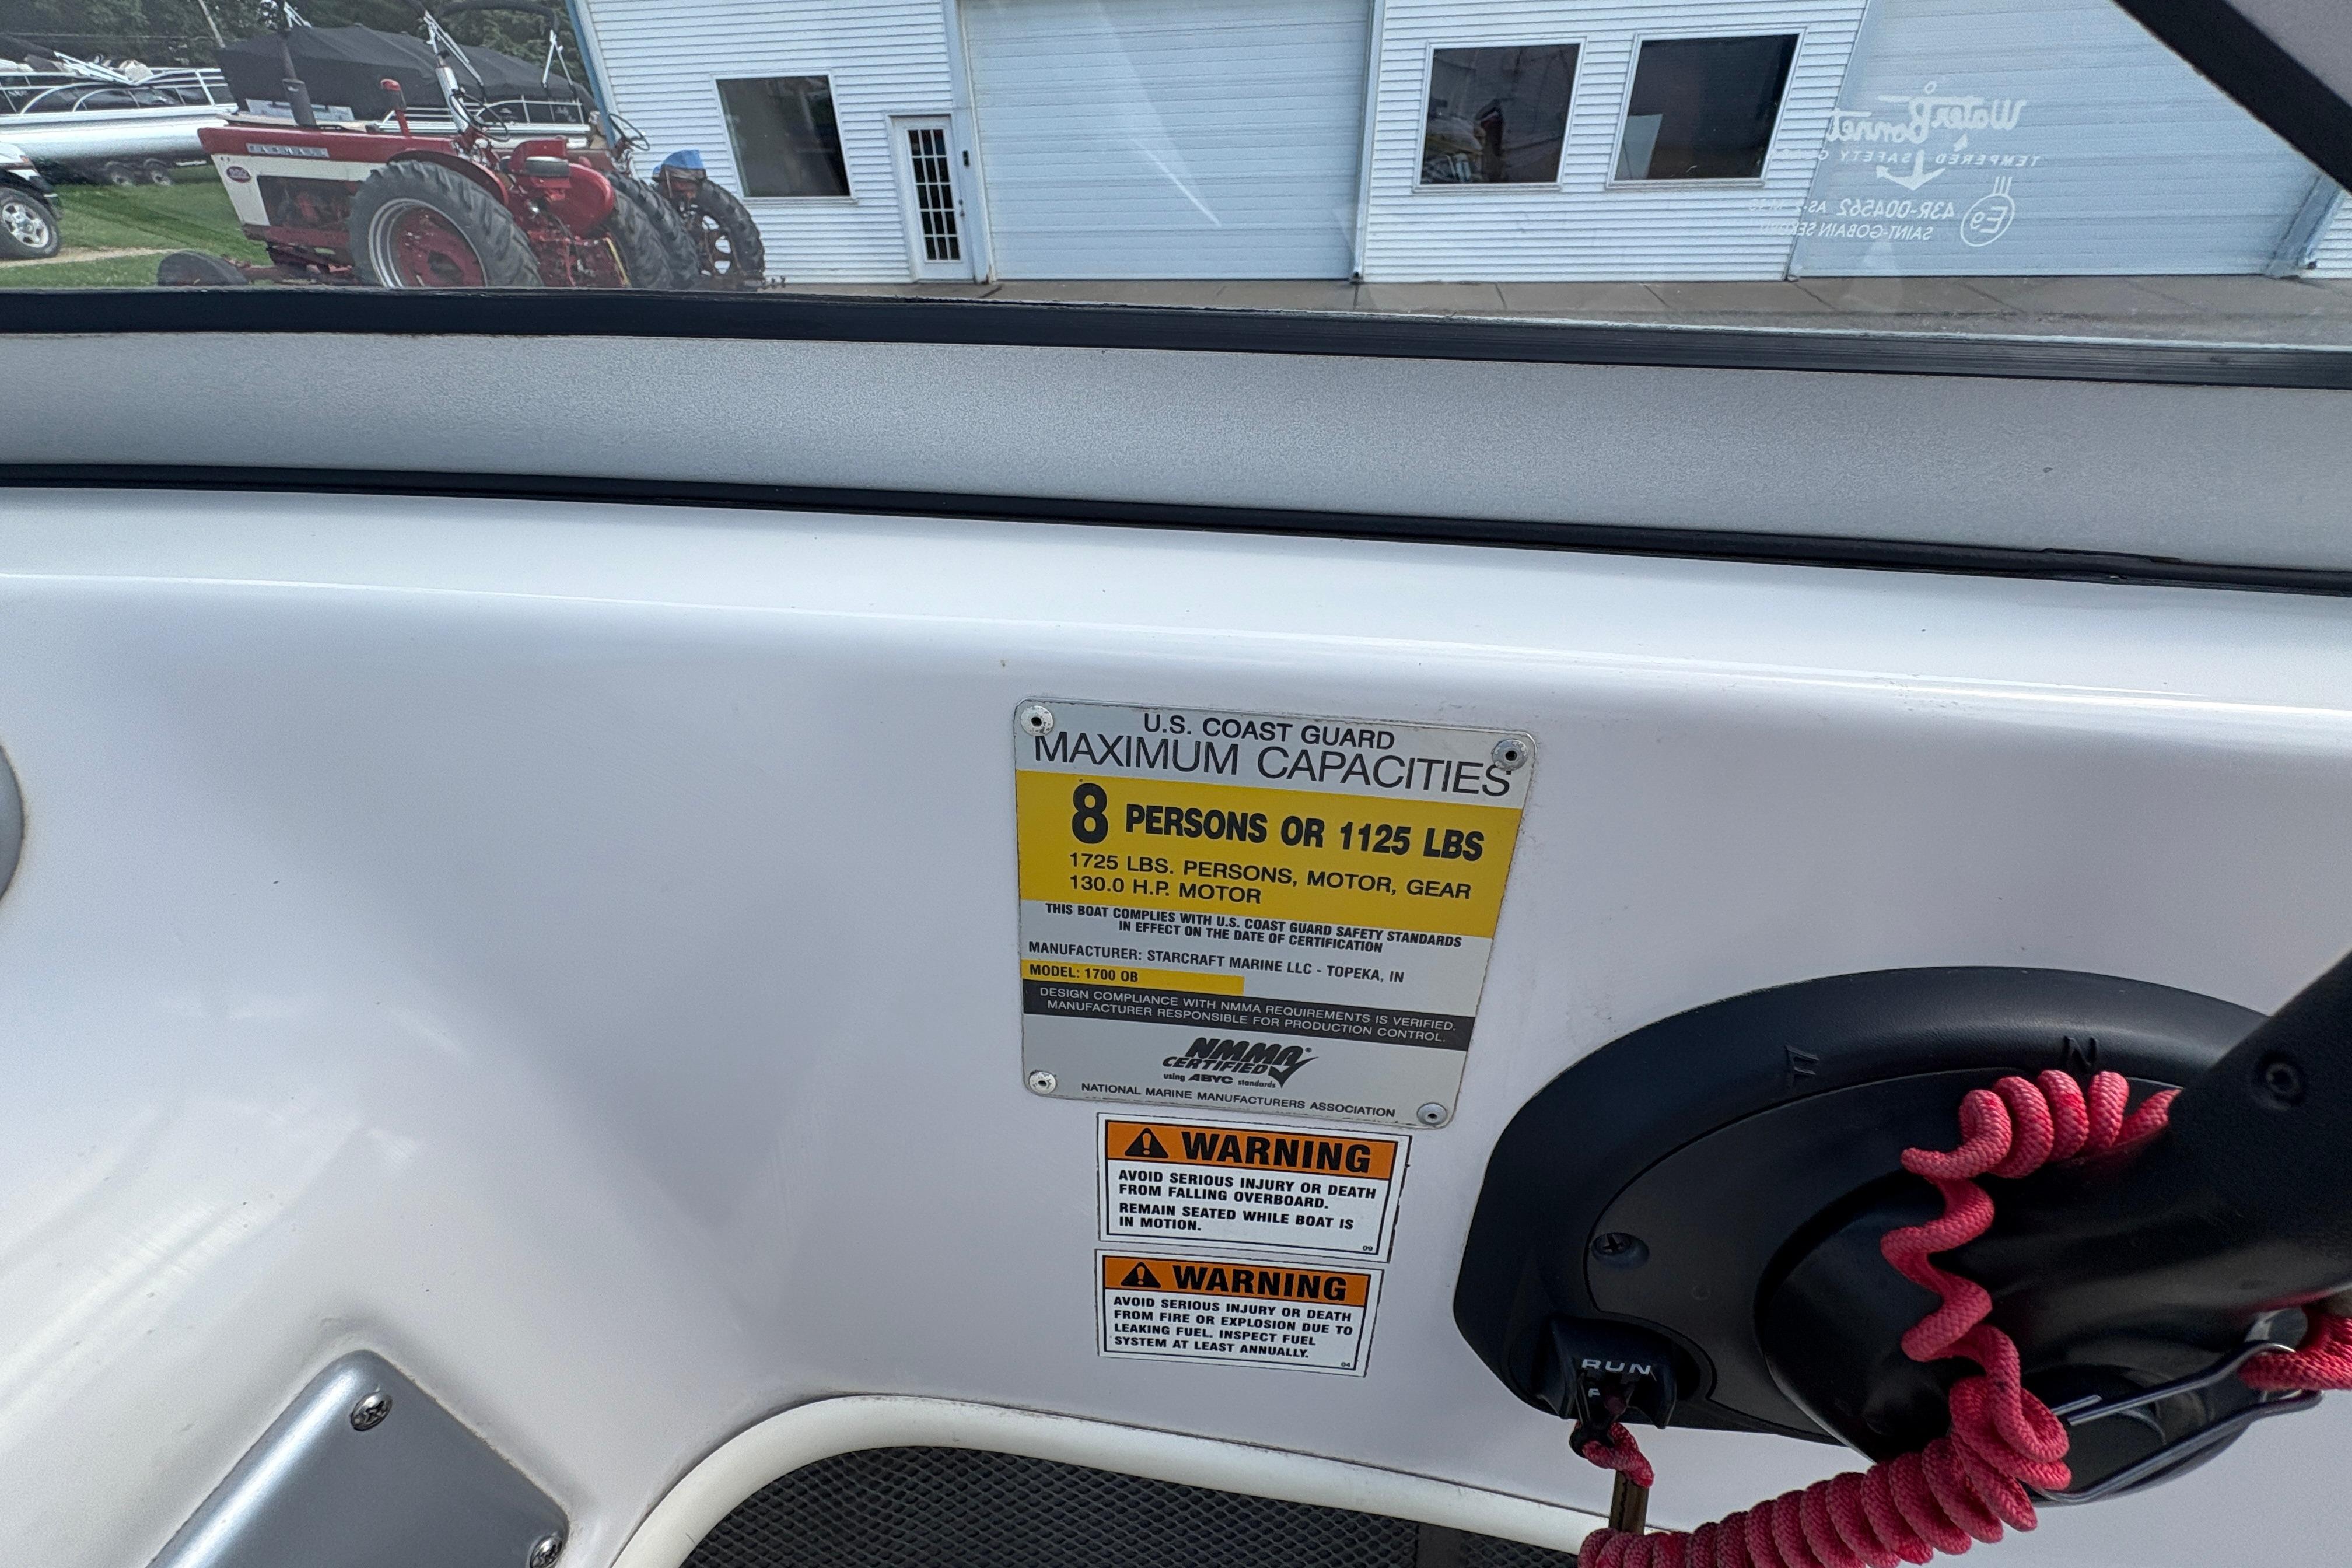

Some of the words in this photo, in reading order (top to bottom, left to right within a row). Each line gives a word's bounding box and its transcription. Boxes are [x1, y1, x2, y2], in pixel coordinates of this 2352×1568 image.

[1144, 713, 1191, 735] U.S.
[1202, 717, 1293, 743] COAST
[1300, 725, 1395, 750] GUARD
[1034, 731, 1238, 775] MAXIMUM
[1258, 746, 1512, 797] CAPACITIES
[1072, 783, 1109, 844] 8
[1125, 803, 1268, 843] PERSONS
[1280, 816, 1325, 848] OR
[1340, 821, 1412, 856] 1125
[1423, 828, 1485, 862] LBS
[1070, 852, 1119, 870] 1725
[1127, 855, 1174, 874] LBS.
[1183, 860, 1297, 887] PERSONS,
[1307, 870, 1396, 896] MOTOR,
[1406, 878, 1472, 900] GEAR
[1070, 874, 1125, 893] 130.0
[1133, 878, 1170, 897] H.P.
[1179, 882, 1261, 904] MOTOR
[1045, 902, 1073, 915] THIS
[1077, 905, 1109, 918] BOAT
[1112, 908, 1176, 923] COMPLIES
[1180, 912, 1212, 926] WITH
[1216, 916, 1240, 929] U.S.
[1244, 918, 1286, 932] COAST
[1289, 922, 1332, 936] GUARD
[1336, 926, 1384, 940] SAFETY
[1386, 930, 1462, 948] STANDARDS
[1118, 921, 1131, 932] IN
[1135, 922, 1181, 936] EFFECT
[1184, 926, 1202, 937] ON
[1206, 928, 1230, 940] THE
[1233, 930, 1265, 943] DATE
[1268, 933, 1285, 944] OF
[1288, 935, 1383, 953] CERTIFICATION
[1028, 941, 1142, 961] MANUFACTURER:
[1147, 950, 1226, 967] STARCRAFT
[1229, 956, 1283, 972] MARINE
[1286, 961, 1312, 975] LLC
[1326, 965, 1384, 983] TOPEKA,
[1389, 971, 1405, 983] IN
[1030, 964, 1080, 979] MODEL:
[1084, 968, 1116, 981] 1700
[1120, 970, 1139, 983] OB
[1040, 986, 1089, 1000] DESIGN
[1093, 991, 1179, 1007] COMPLIANCE
[1182, 998, 1216, 1010] WITH
[1220, 1001, 1262, 1014] NMMA
[1265, 1005, 1371, 1024] REQUIREMENTS
[1374, 1014, 1389, 1025] IS
[1393, 1016, 1457, 1031] VERIFIED.
[1047, 1000, 1153, 1017] MANUFACTURER
[1157, 1008, 1248, 1024] RESPONSIBLE
[1252, 1016, 1280, 1027] FOR
[1284, 1019, 1373, 1035] PRODUCTION
[1377, 1027, 1446, 1042] CONTROL.
[1162, 1056, 1269, 1075] CERTIFIED
[2063, 1036, 2099, 1073] N
[1163, 1072, 1186, 1083] using
[1188, 1073, 1234, 1085] ABYC
[1237, 1079, 1276, 1089] standards
[1081, 1083, 1142, 1096] NATIONAL
[1145, 1087, 1192, 1100] MARINE
[1196, 1091, 1306, 1109] MANUFACTURERS
[1310, 1101, 1395, 1118] ASSOCIATION
[1181, 1131, 1371, 1174] WARNING
[1118, 1169, 1163, 1183] AVOID
[1170, 1172, 1234, 1188] SERIOUS
[1240, 1177, 1295, 1192] INJURY
[1300, 1182, 1321, 1195] OR
[1327, 1185, 1377, 1199] DEATH
[1119, 1184, 1161, 1196] FROM
[1168, 1186, 1227, 1201] FALLING
[1233, 1191, 1329, 1209] OVERBOARD.
[1119, 1202, 1176, 1216] REMAIN
[1182, 1206, 1236, 1220] SEATED
[1242, 1210, 1290, 1224] WHILE
[1295, 1214, 1335, 1229] BOAT
[1339, 1218, 1354, 1230] IS
[1119, 1216, 1133, 1227] IN
[1140, 1217, 1202, 1231] MOTION.
[1172, 1265, 1346, 1301] WARNING
[1113, 1296, 1155, 1307] AVOID
[1161, 1298, 1220, 1312] SERIOUS
[1226, 1303, 1276, 1316] INJURY
[1282, 1307, 1301, 1318] OR
[1307, 1309, 1352, 1322] DEATH
[1114, 1310, 1153, 1321] FROM
[1159, 1312, 1191, 1324] FIRE
[1196, 1315, 1215, 1325] OR
[1220, 1317, 1296, 1331] EXPLOSION
[1301, 1322, 1330, 1334] DUE
[1335, 1325, 1353, 1336] TO
[1114, 1323, 1170, 1335] LEAKING
[1175, 1326, 1213, 1338] FUEL.
[1219, 1329, 1278, 1343] INSPECT
[1282, 1334, 1316, 1346] FUEL
[1114, 1336, 1167, 1348] SYSTEM
[1172, 1340, 1189, 1349] AT
[1194, 1342, 1236, 1353] LEAST
[1239, 1344, 1309, 1359] ANNUALLY.
[1581, 1359, 1651, 1376] RUN
